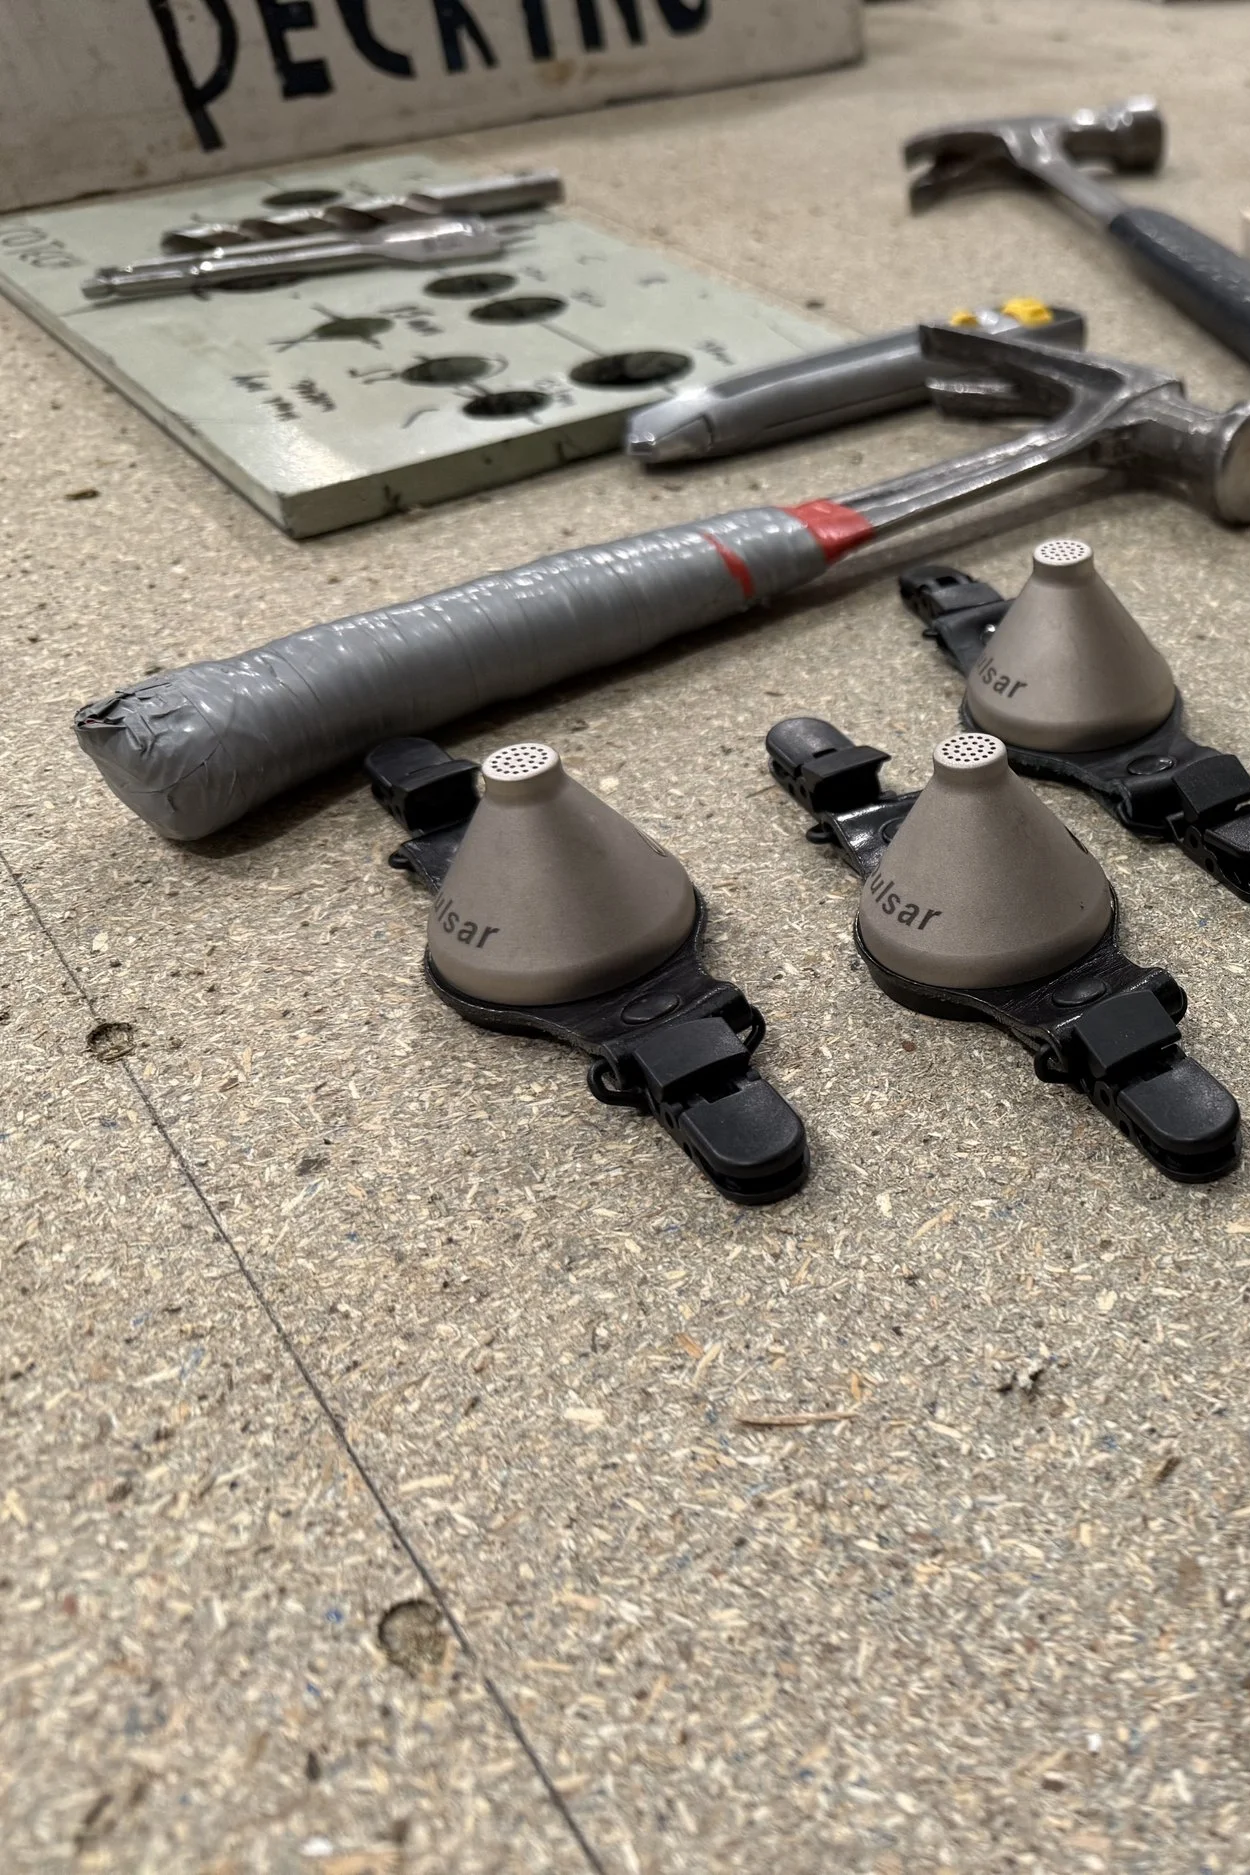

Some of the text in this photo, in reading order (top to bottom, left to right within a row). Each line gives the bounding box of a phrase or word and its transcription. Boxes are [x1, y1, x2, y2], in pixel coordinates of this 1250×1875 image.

[976, 655, 1028, 698] lsar
[433, 891, 501, 949] ulsar
[870, 863, 943, 931] ulsar
